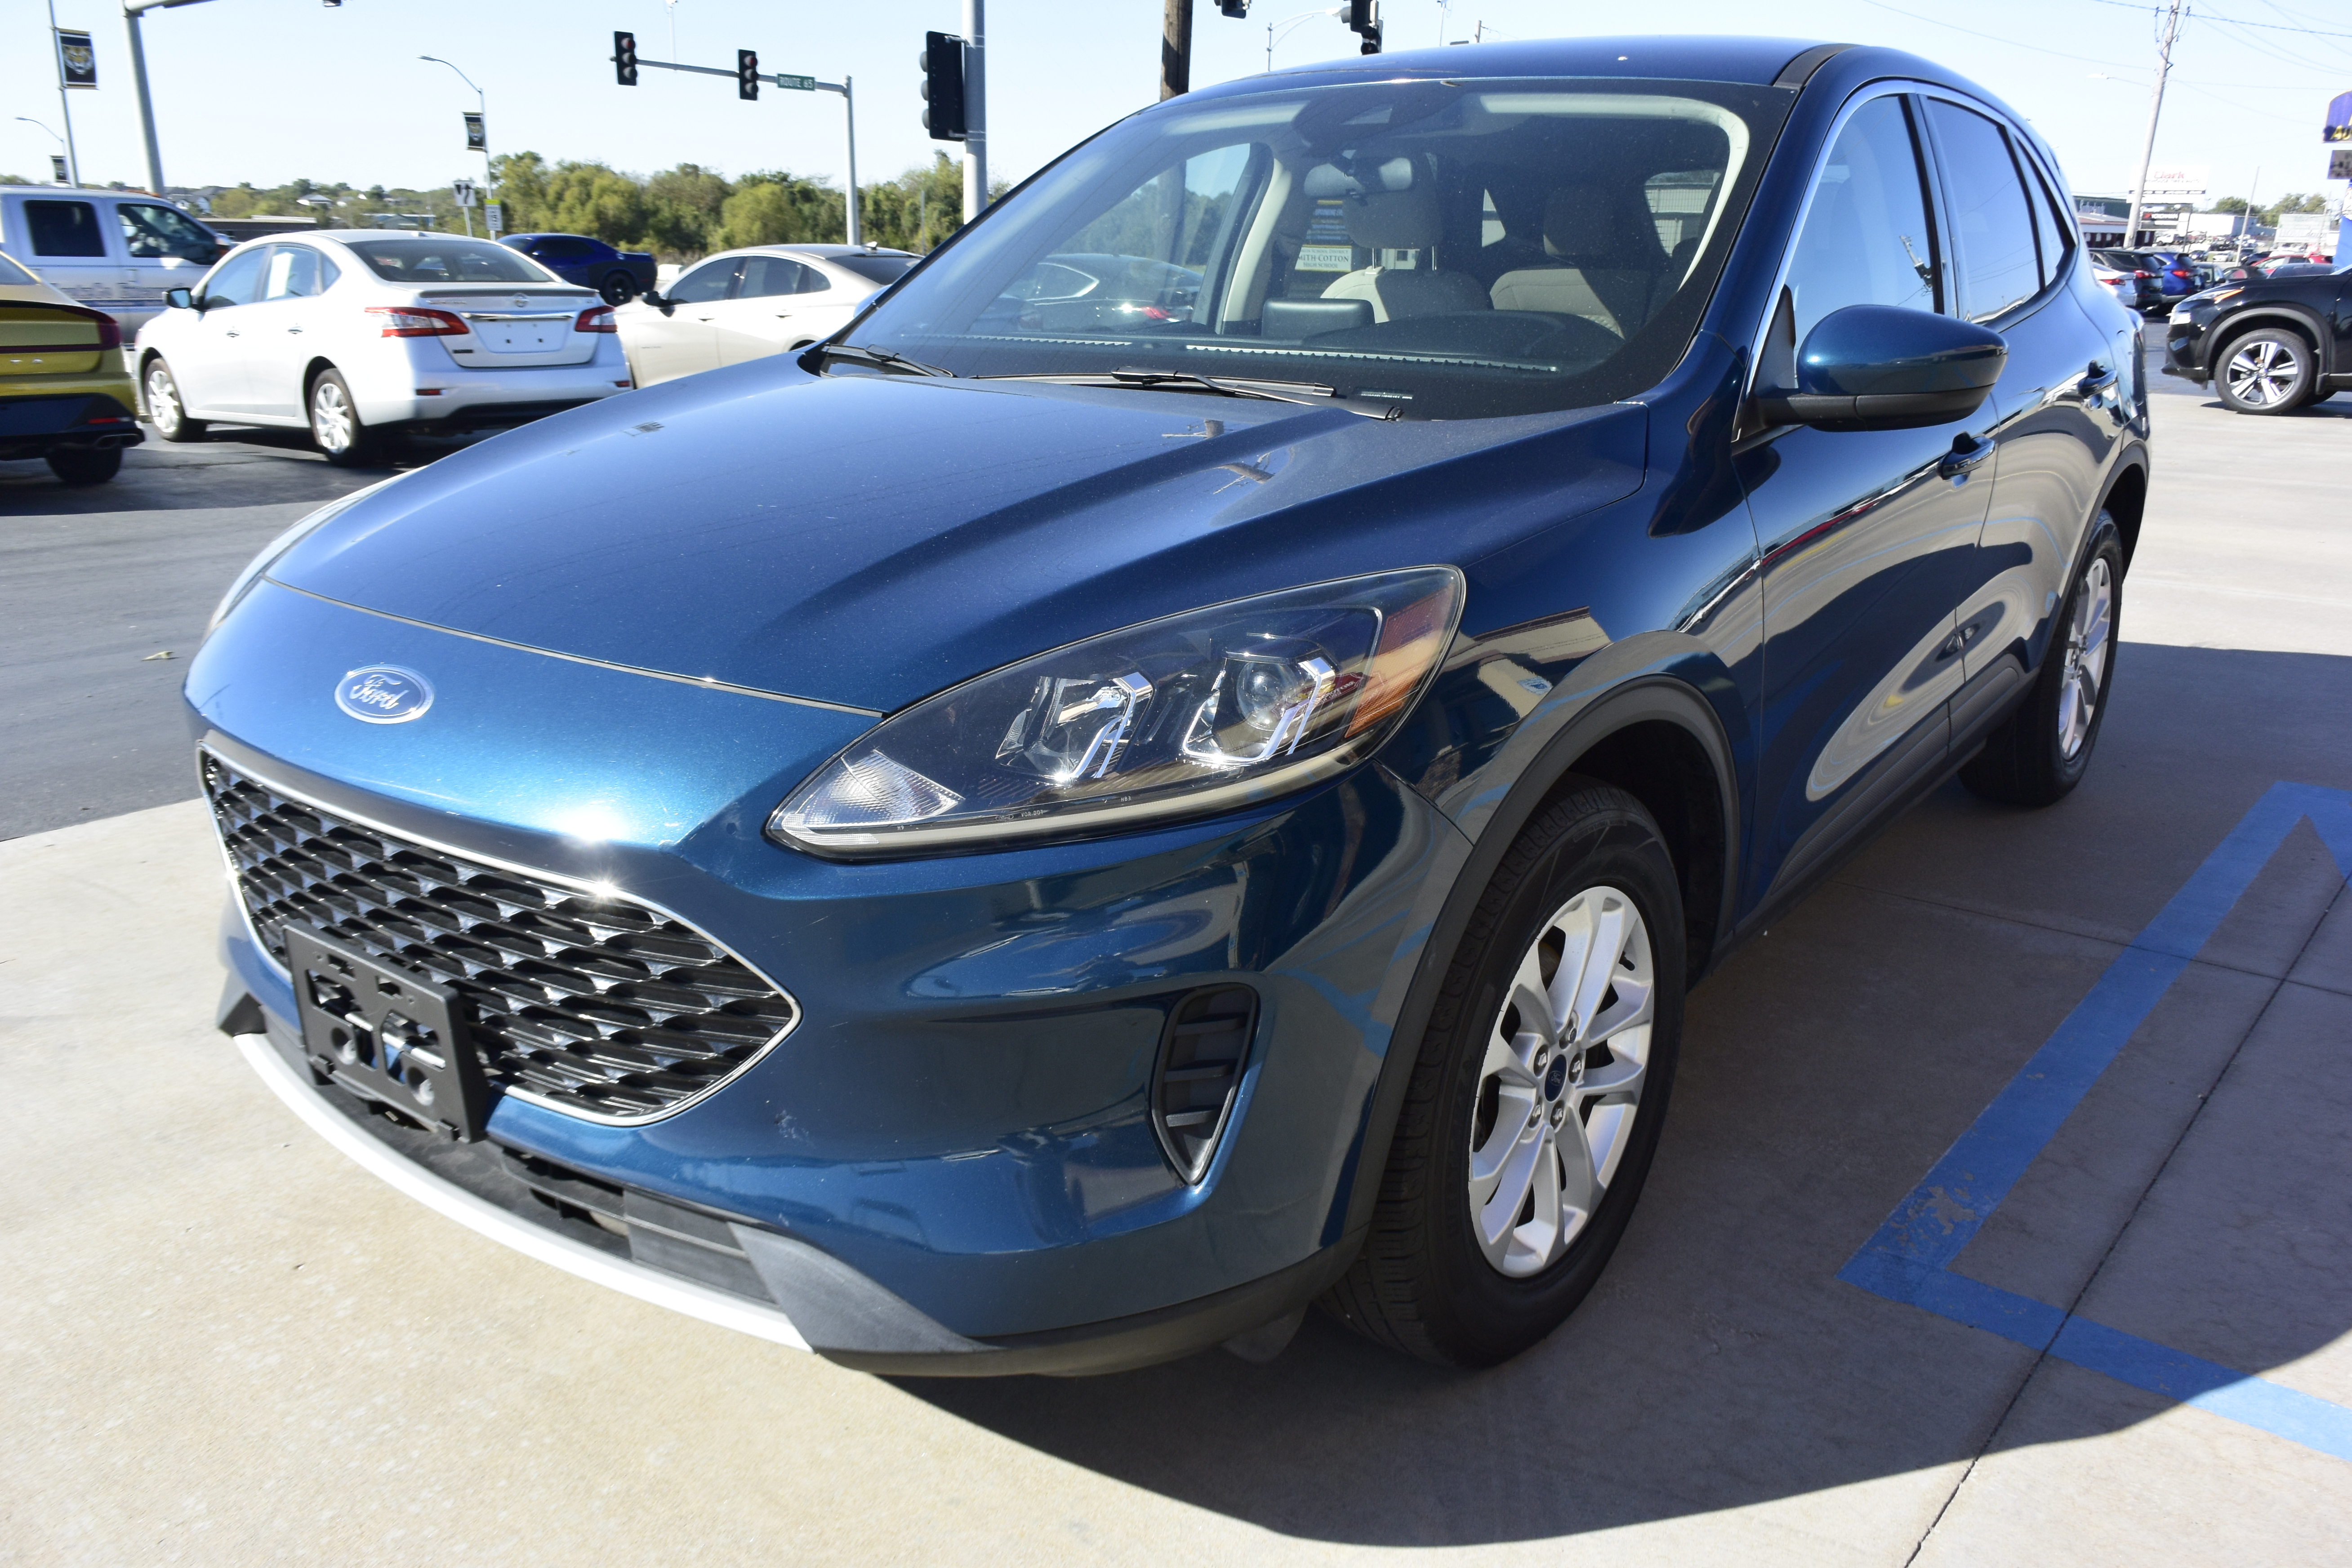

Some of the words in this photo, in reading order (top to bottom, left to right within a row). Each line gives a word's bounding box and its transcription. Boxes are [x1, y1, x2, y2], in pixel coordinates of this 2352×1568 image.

[779, 76, 802, 88] ROUTE
[803, 79, 814, 89] 65
[349, 674, 410, 710] Ford
